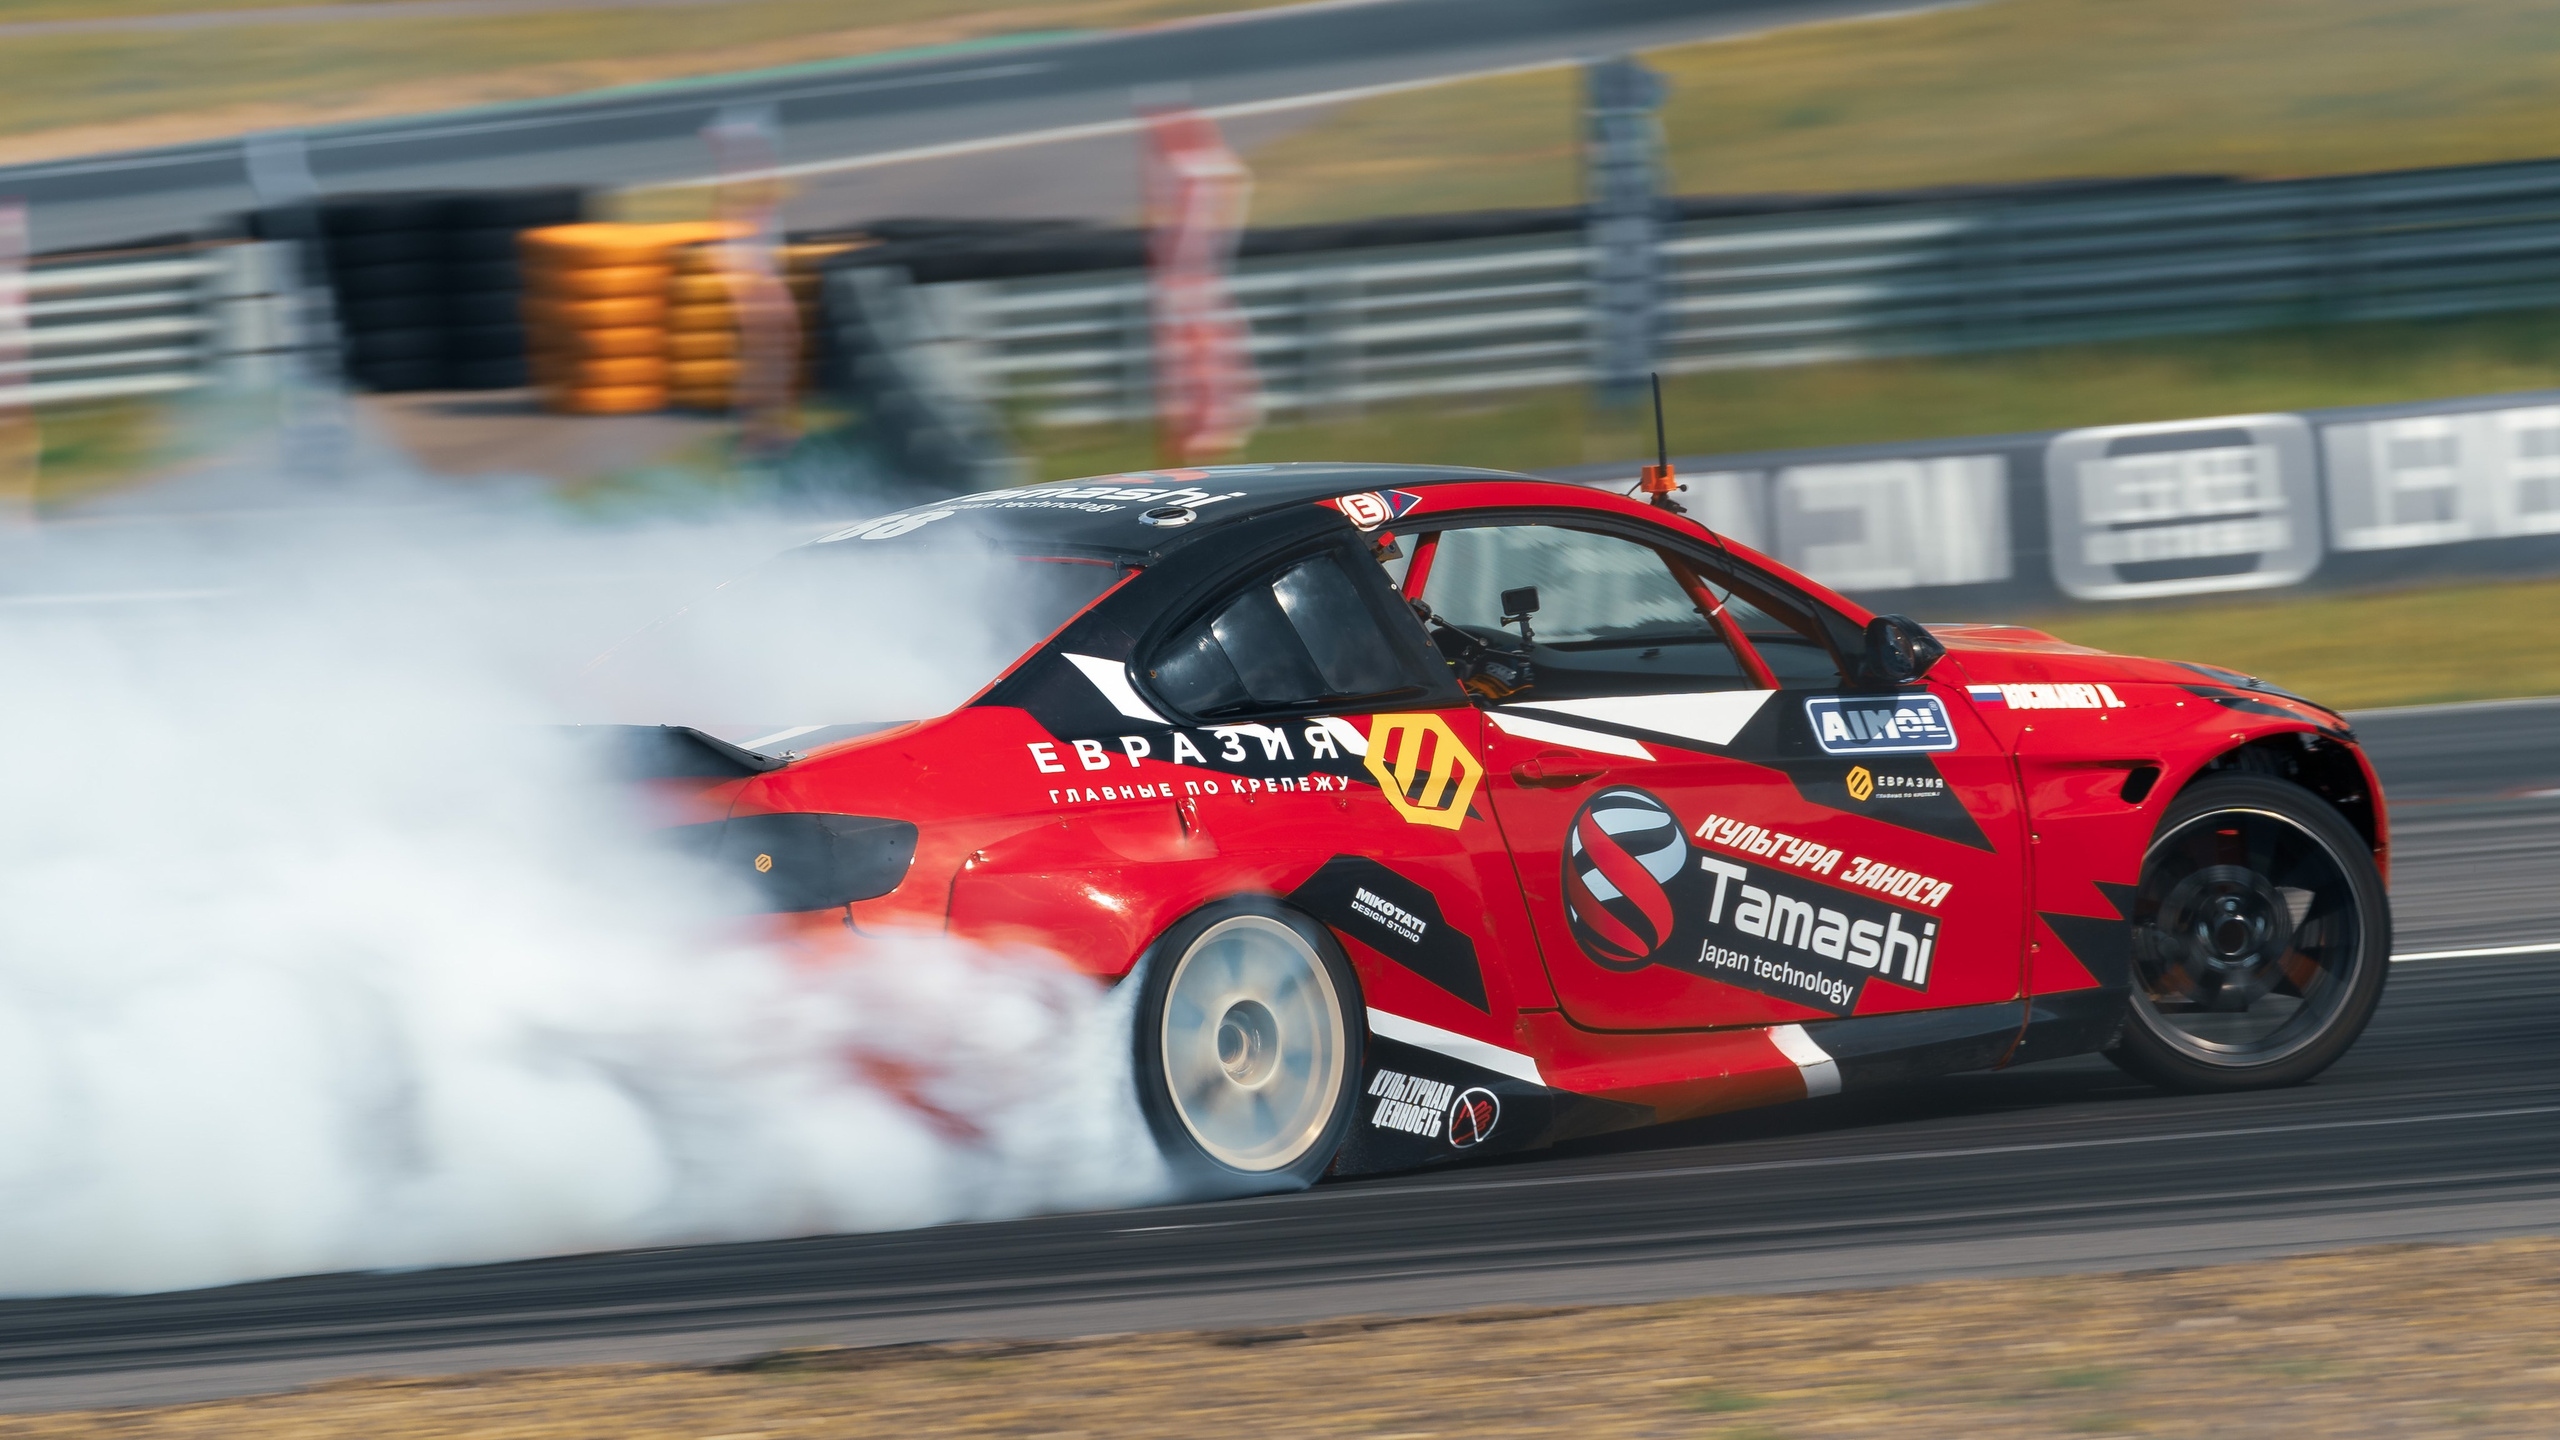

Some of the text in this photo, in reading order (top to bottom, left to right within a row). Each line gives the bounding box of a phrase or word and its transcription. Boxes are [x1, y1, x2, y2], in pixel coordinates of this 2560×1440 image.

[1821, 708, 1949, 742] AIMOL
[1026, 726, 1339, 774] ЕВРАЗИЯ
[1049, 775, 1349, 804] ГЛАВНЫЕ ПО КРЕПЕЖУ
[1877, 775, 1944, 789] ЕВРАЗИЯ
[1695, 814, 1953, 908] КУЛЬТУРА ЗАНОСА
[1351, 900, 1420, 943] DESIGN STUDIO
[1355, 887, 1427, 934] MIKOTATI
[1700, 856, 1937, 985] Tamashi
[1698, 939, 1854, 1006] Japan technology
[1367, 1068, 1456, 1112] КУЛЬТУРНАЯ
[1371, 1097, 1442, 1138] ЦЕННОСТЬ
